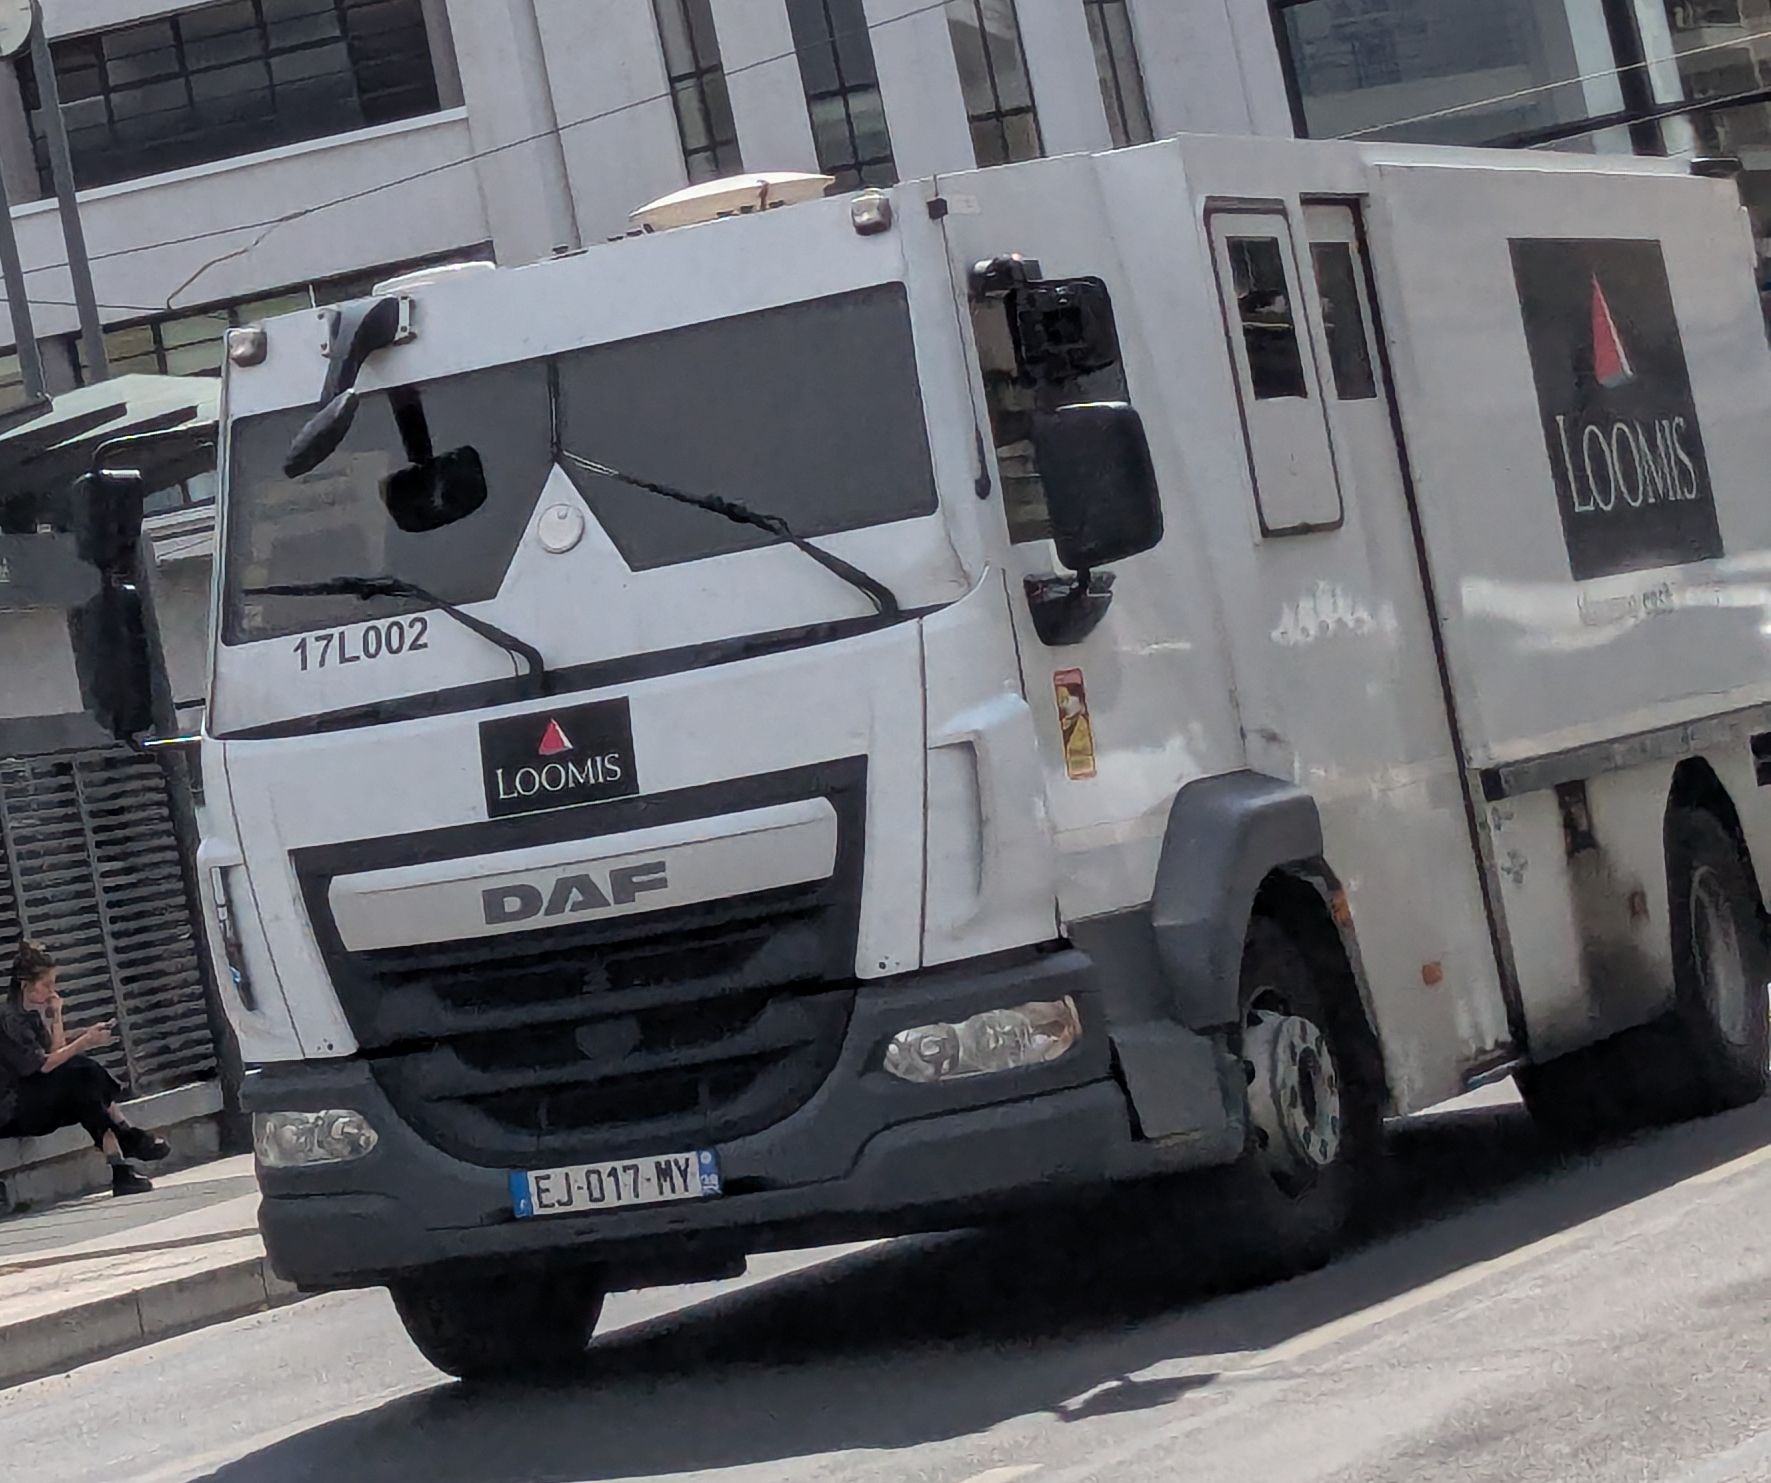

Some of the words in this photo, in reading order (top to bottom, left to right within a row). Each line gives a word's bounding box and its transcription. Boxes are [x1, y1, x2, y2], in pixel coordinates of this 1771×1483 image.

[1555, 415, 1697, 512] LOOMIS
[293, 616, 429, 671] 17L002
[495, 753, 622, 799] LOOMIS
[482, 860, 668, 925] DAF
[534, 1156, 691, 1209] EJ-017-MY
